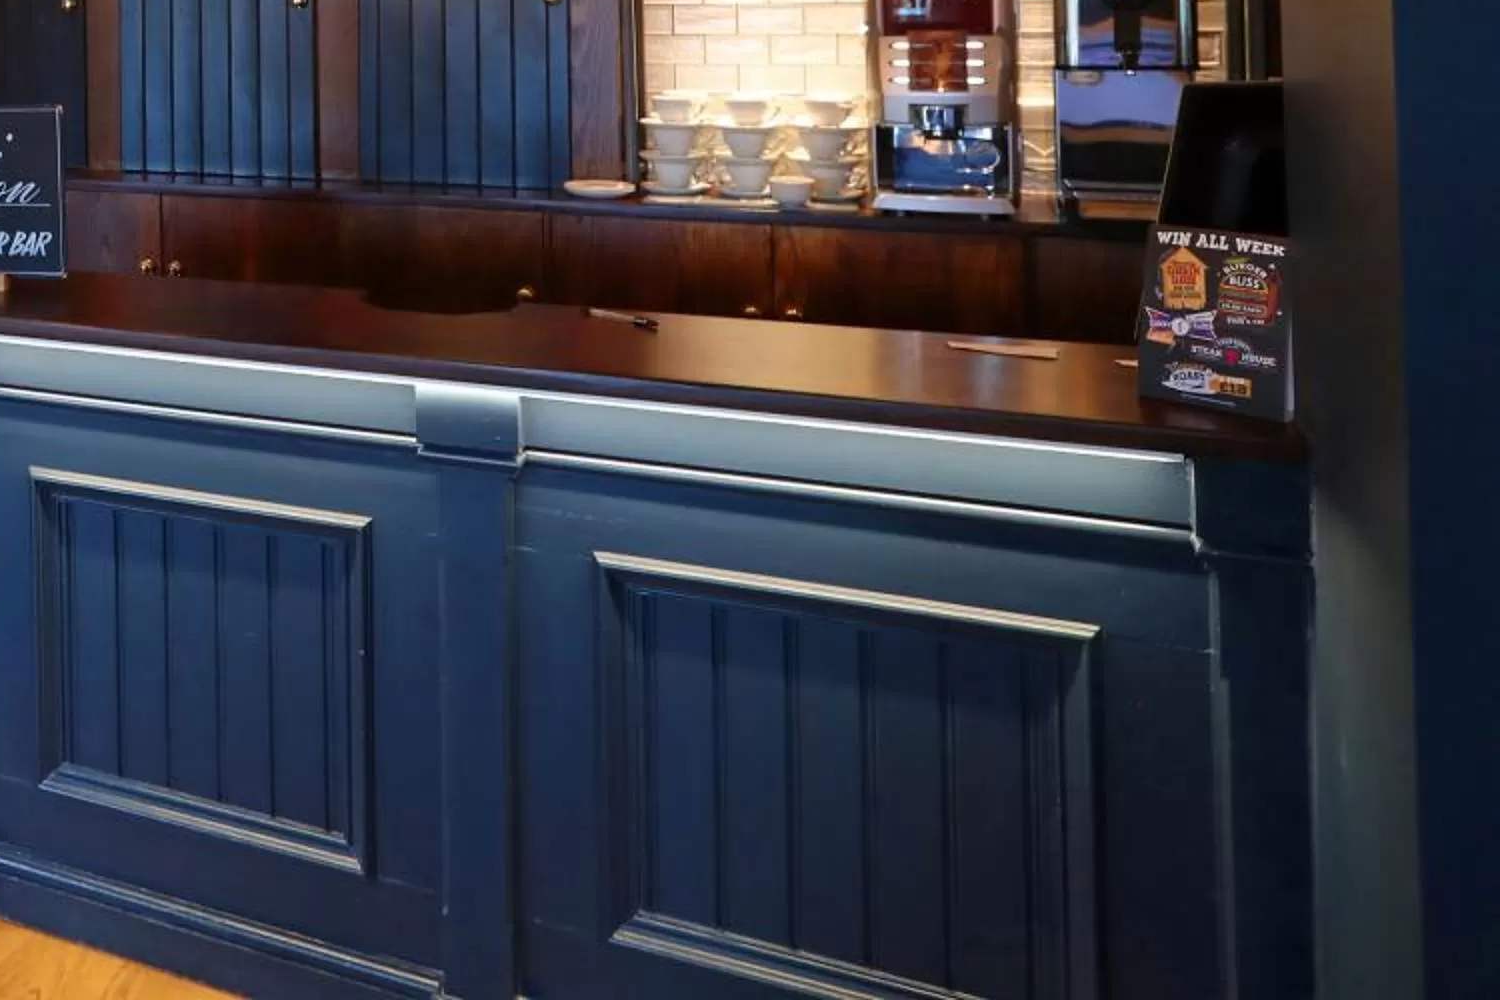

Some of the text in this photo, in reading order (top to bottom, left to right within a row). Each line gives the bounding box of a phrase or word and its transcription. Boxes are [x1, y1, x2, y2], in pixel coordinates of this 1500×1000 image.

[8, 230, 53, 257] BAR
[1157, 231, 1285, 257] WIN ALL WEEK
